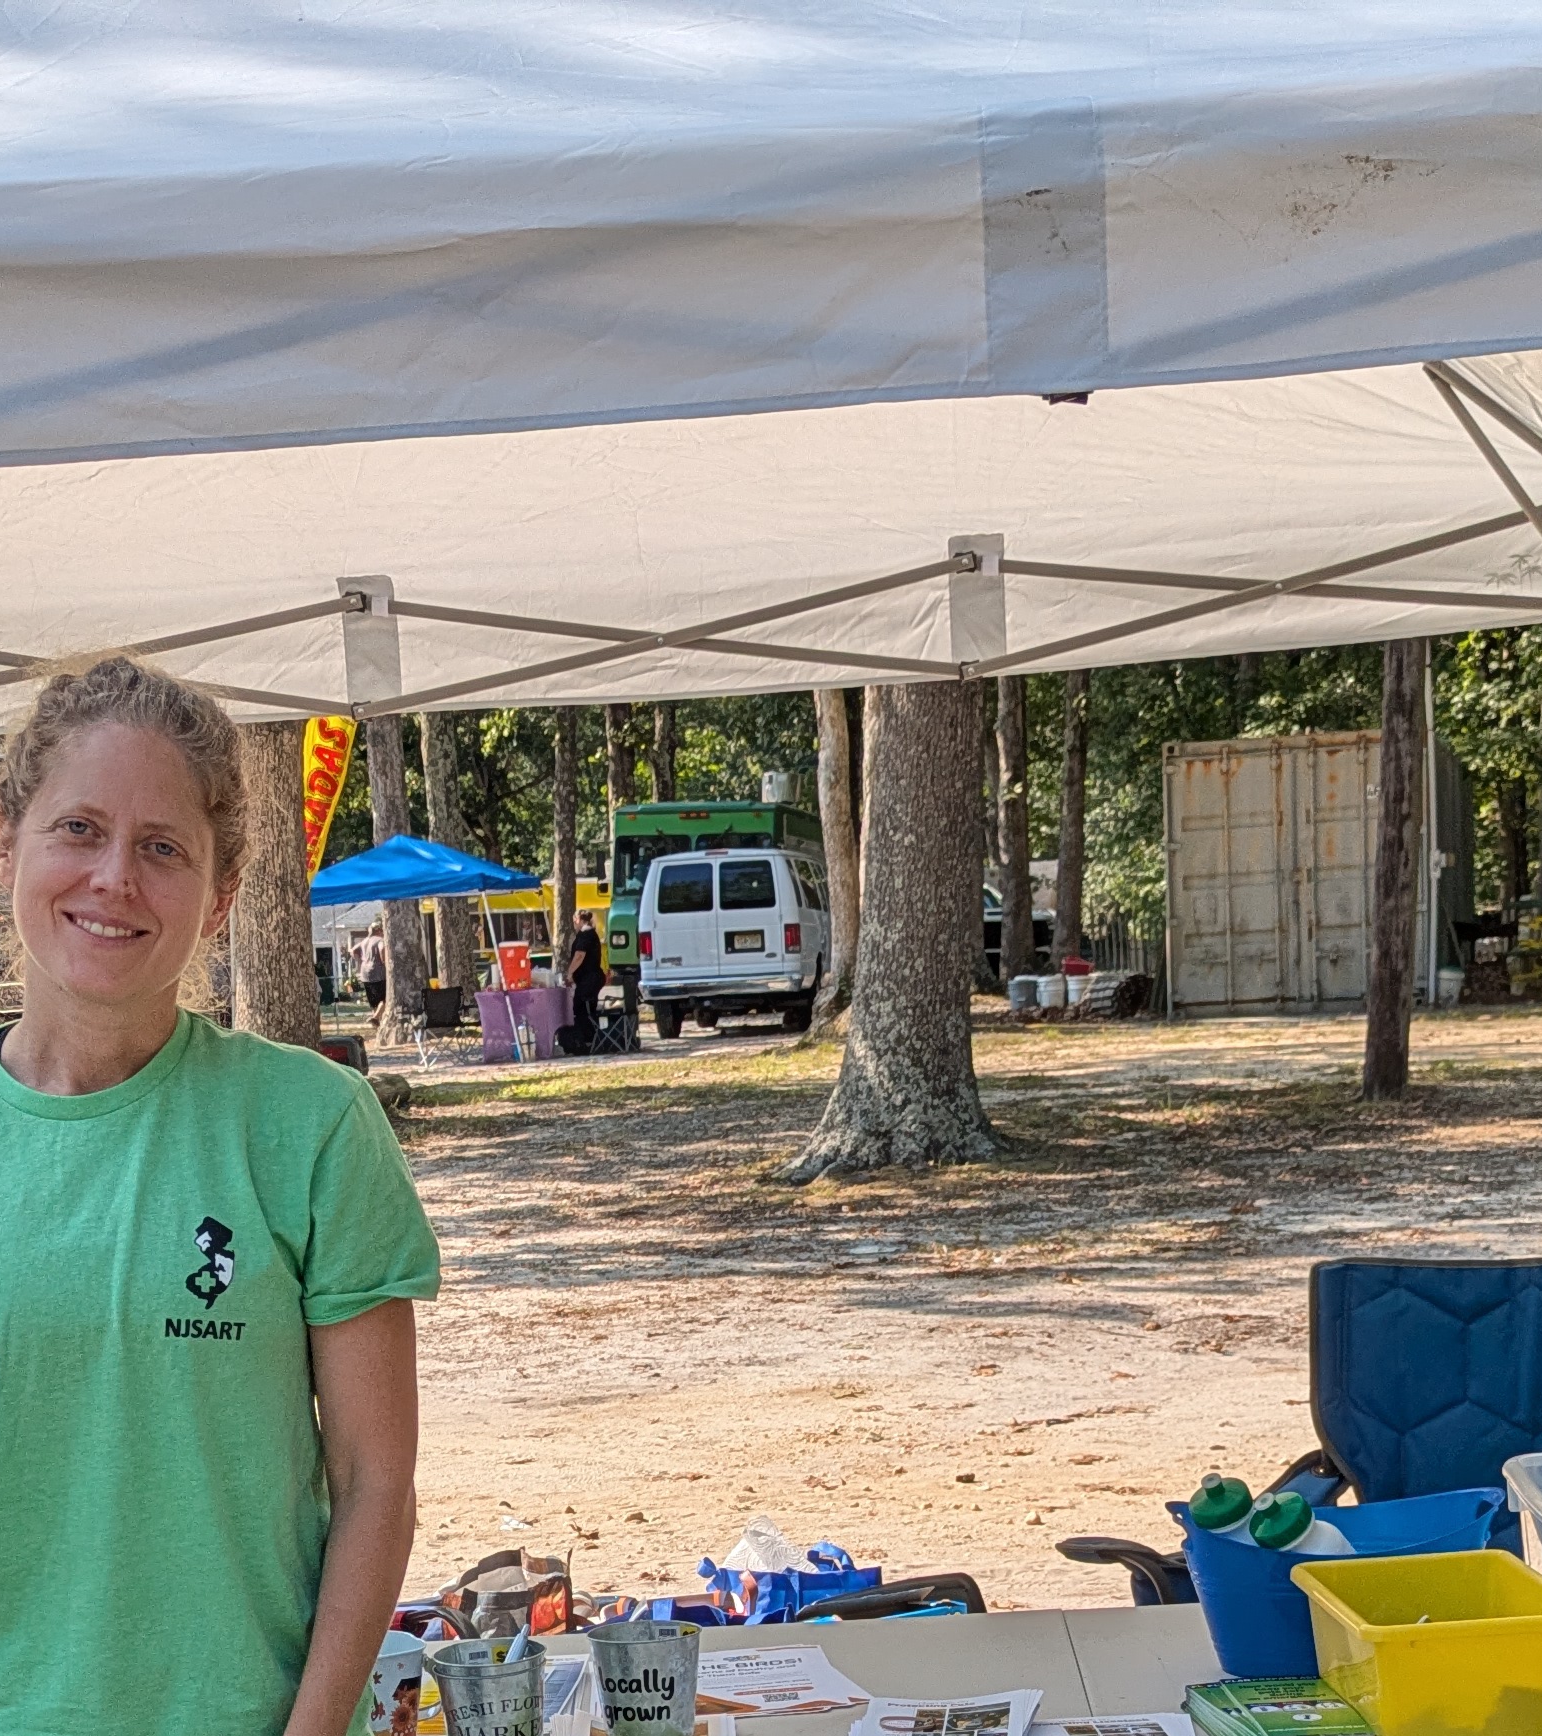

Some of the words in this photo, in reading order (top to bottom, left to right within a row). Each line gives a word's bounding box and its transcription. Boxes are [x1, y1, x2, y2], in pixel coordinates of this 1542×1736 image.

[303, 716, 349, 872] NADAS
[164, 1317, 247, 1341] NJSART
[735, 1657, 803, 1668] BIRDS!
[599, 1668, 675, 1701] locally
[603, 1704, 672, 1730] grown
